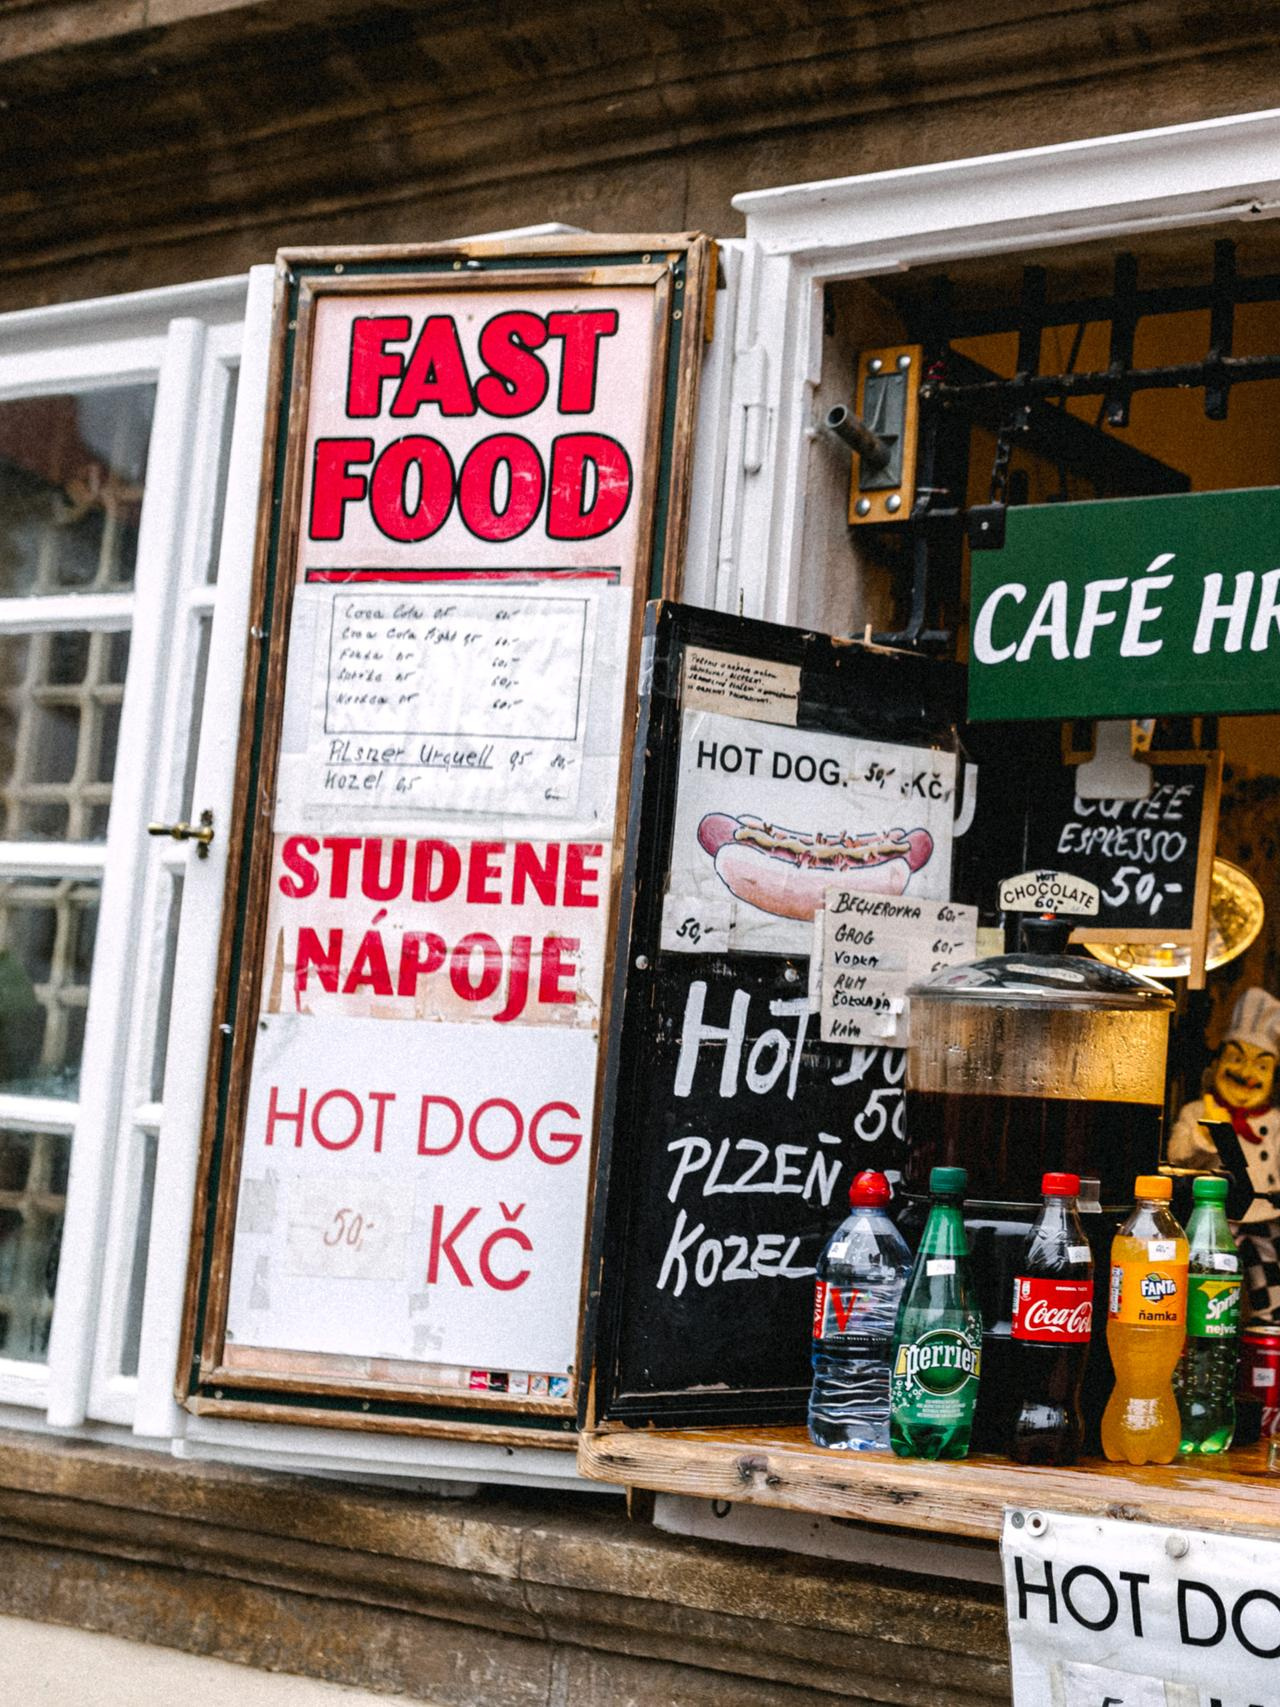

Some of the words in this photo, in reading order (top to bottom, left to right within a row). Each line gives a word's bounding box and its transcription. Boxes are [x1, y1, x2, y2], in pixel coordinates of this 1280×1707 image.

[346, 309, 619, 418] FAST
[308, 432, 633, 542] FOOD
[973, 552, 1177, 665] CAFÉ
[697, 741, 763, 775] HOT
[278, 835, 604, 908] STUDENE
[1004, 882, 1094, 909] CHOCOLATE
[294, 908, 582, 1022] NÁPOJE
[265, 1086, 396, 1153] HOT
[417, 1094, 583, 1165] DOG
[1014, 1556, 1150, 1637] HOT
